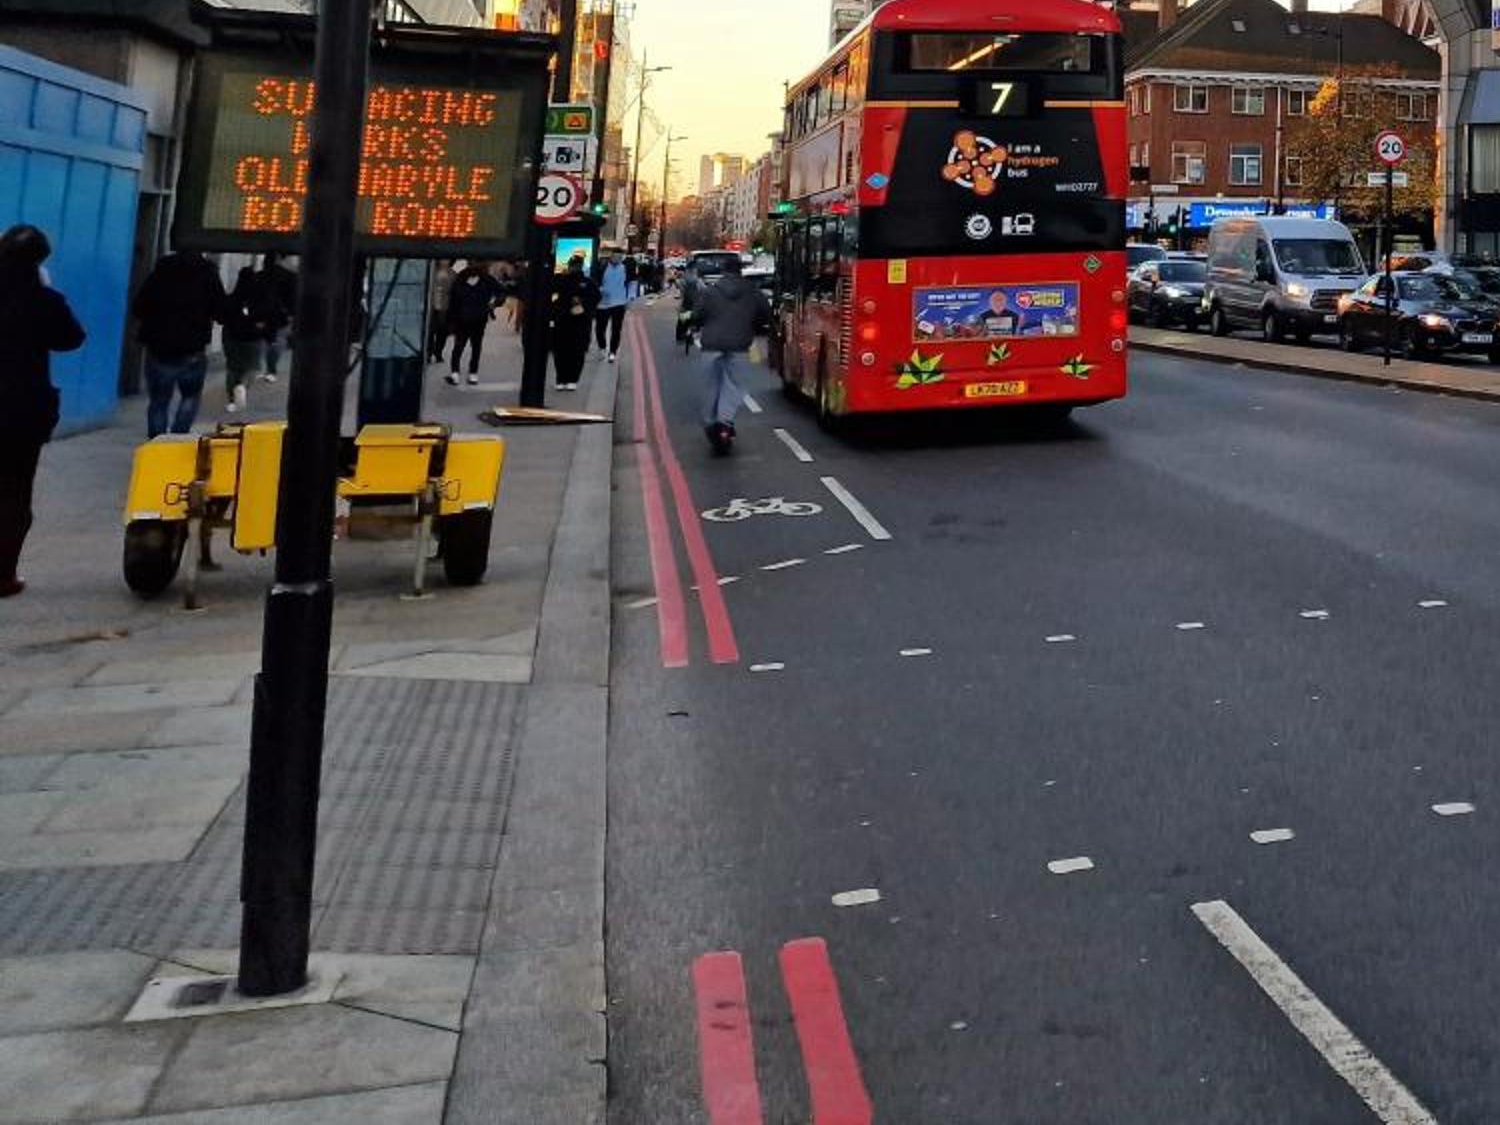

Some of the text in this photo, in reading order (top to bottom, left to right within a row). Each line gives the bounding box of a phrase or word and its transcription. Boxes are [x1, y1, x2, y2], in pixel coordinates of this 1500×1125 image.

[254, 77, 497, 126] SUACING
[991, 82, 1014, 114] 7
[291, 121, 448, 161] WRKS
[1381, 140, 1401, 154] 20
[357, 161, 494, 199] ARYLE
[1007, 168, 1029, 178] bus
[537, 186, 571, 207] 20
[370, 200, 477, 238] ROAD
